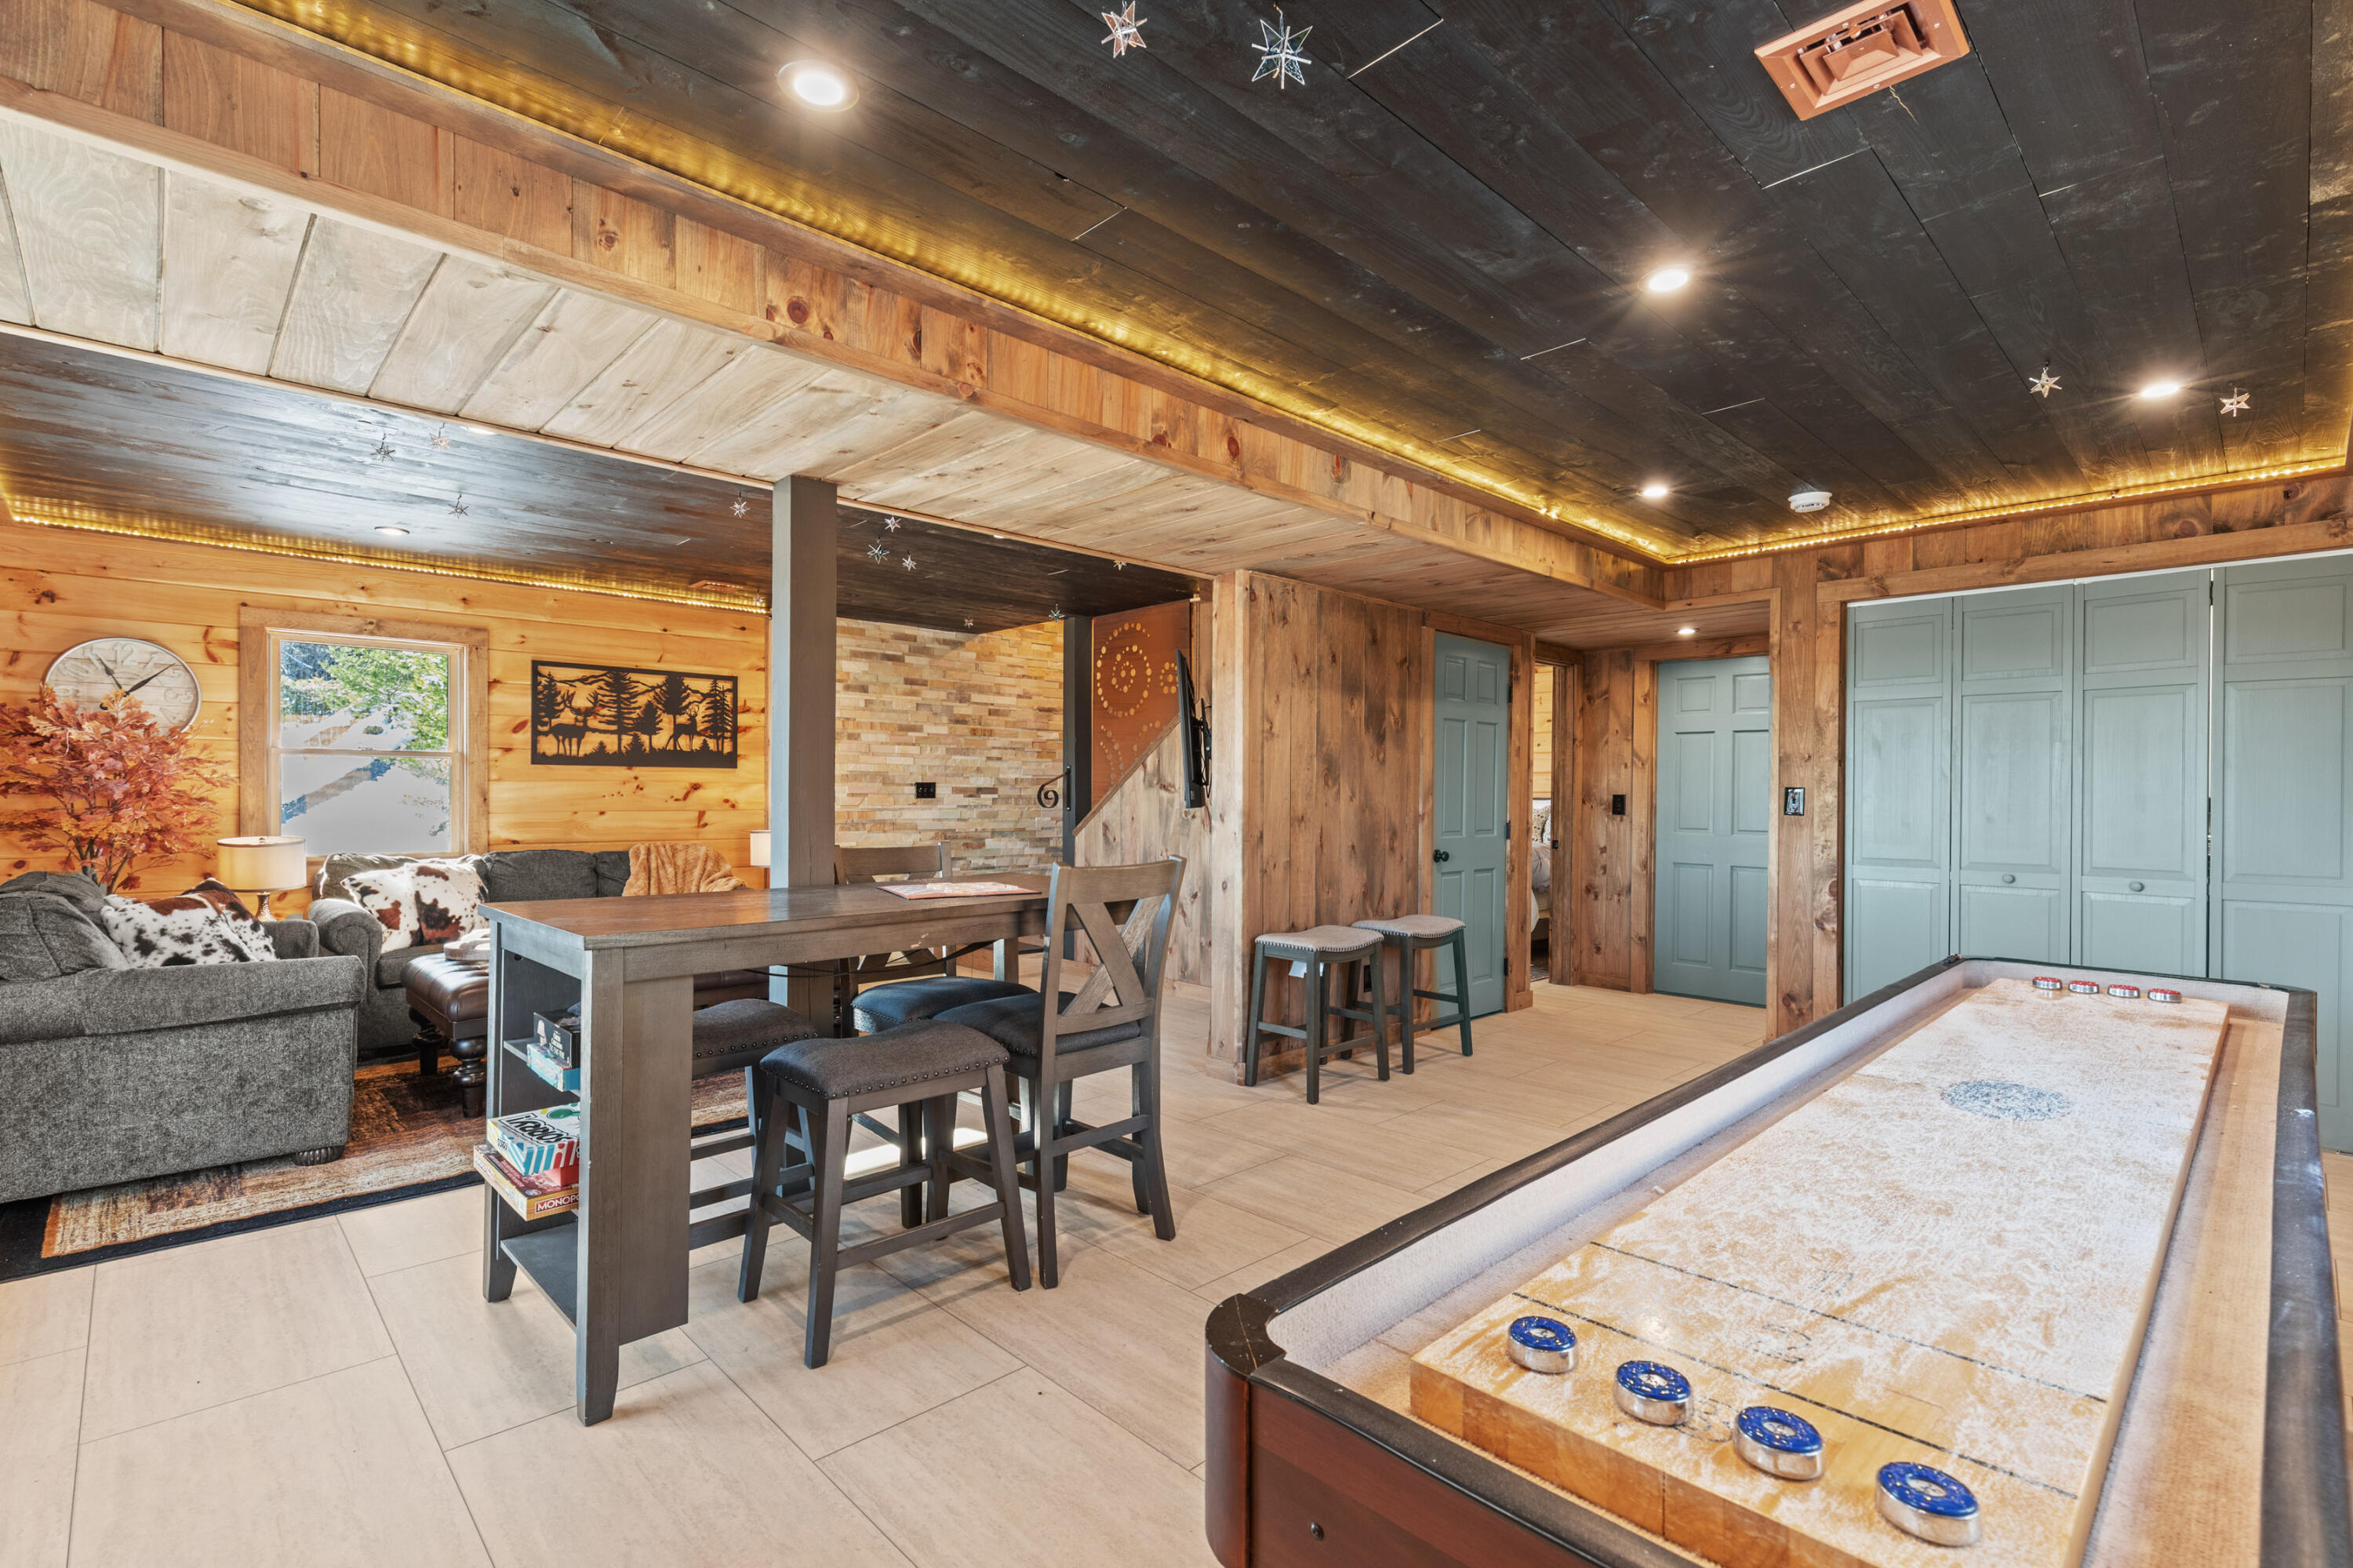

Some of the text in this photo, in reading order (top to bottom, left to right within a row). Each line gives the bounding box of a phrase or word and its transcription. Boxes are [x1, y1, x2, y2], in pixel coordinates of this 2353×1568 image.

[113, 642, 139, 666] 12
[59, 657, 93, 679] 10
[504, 1115, 573, 1144] SORRY!
